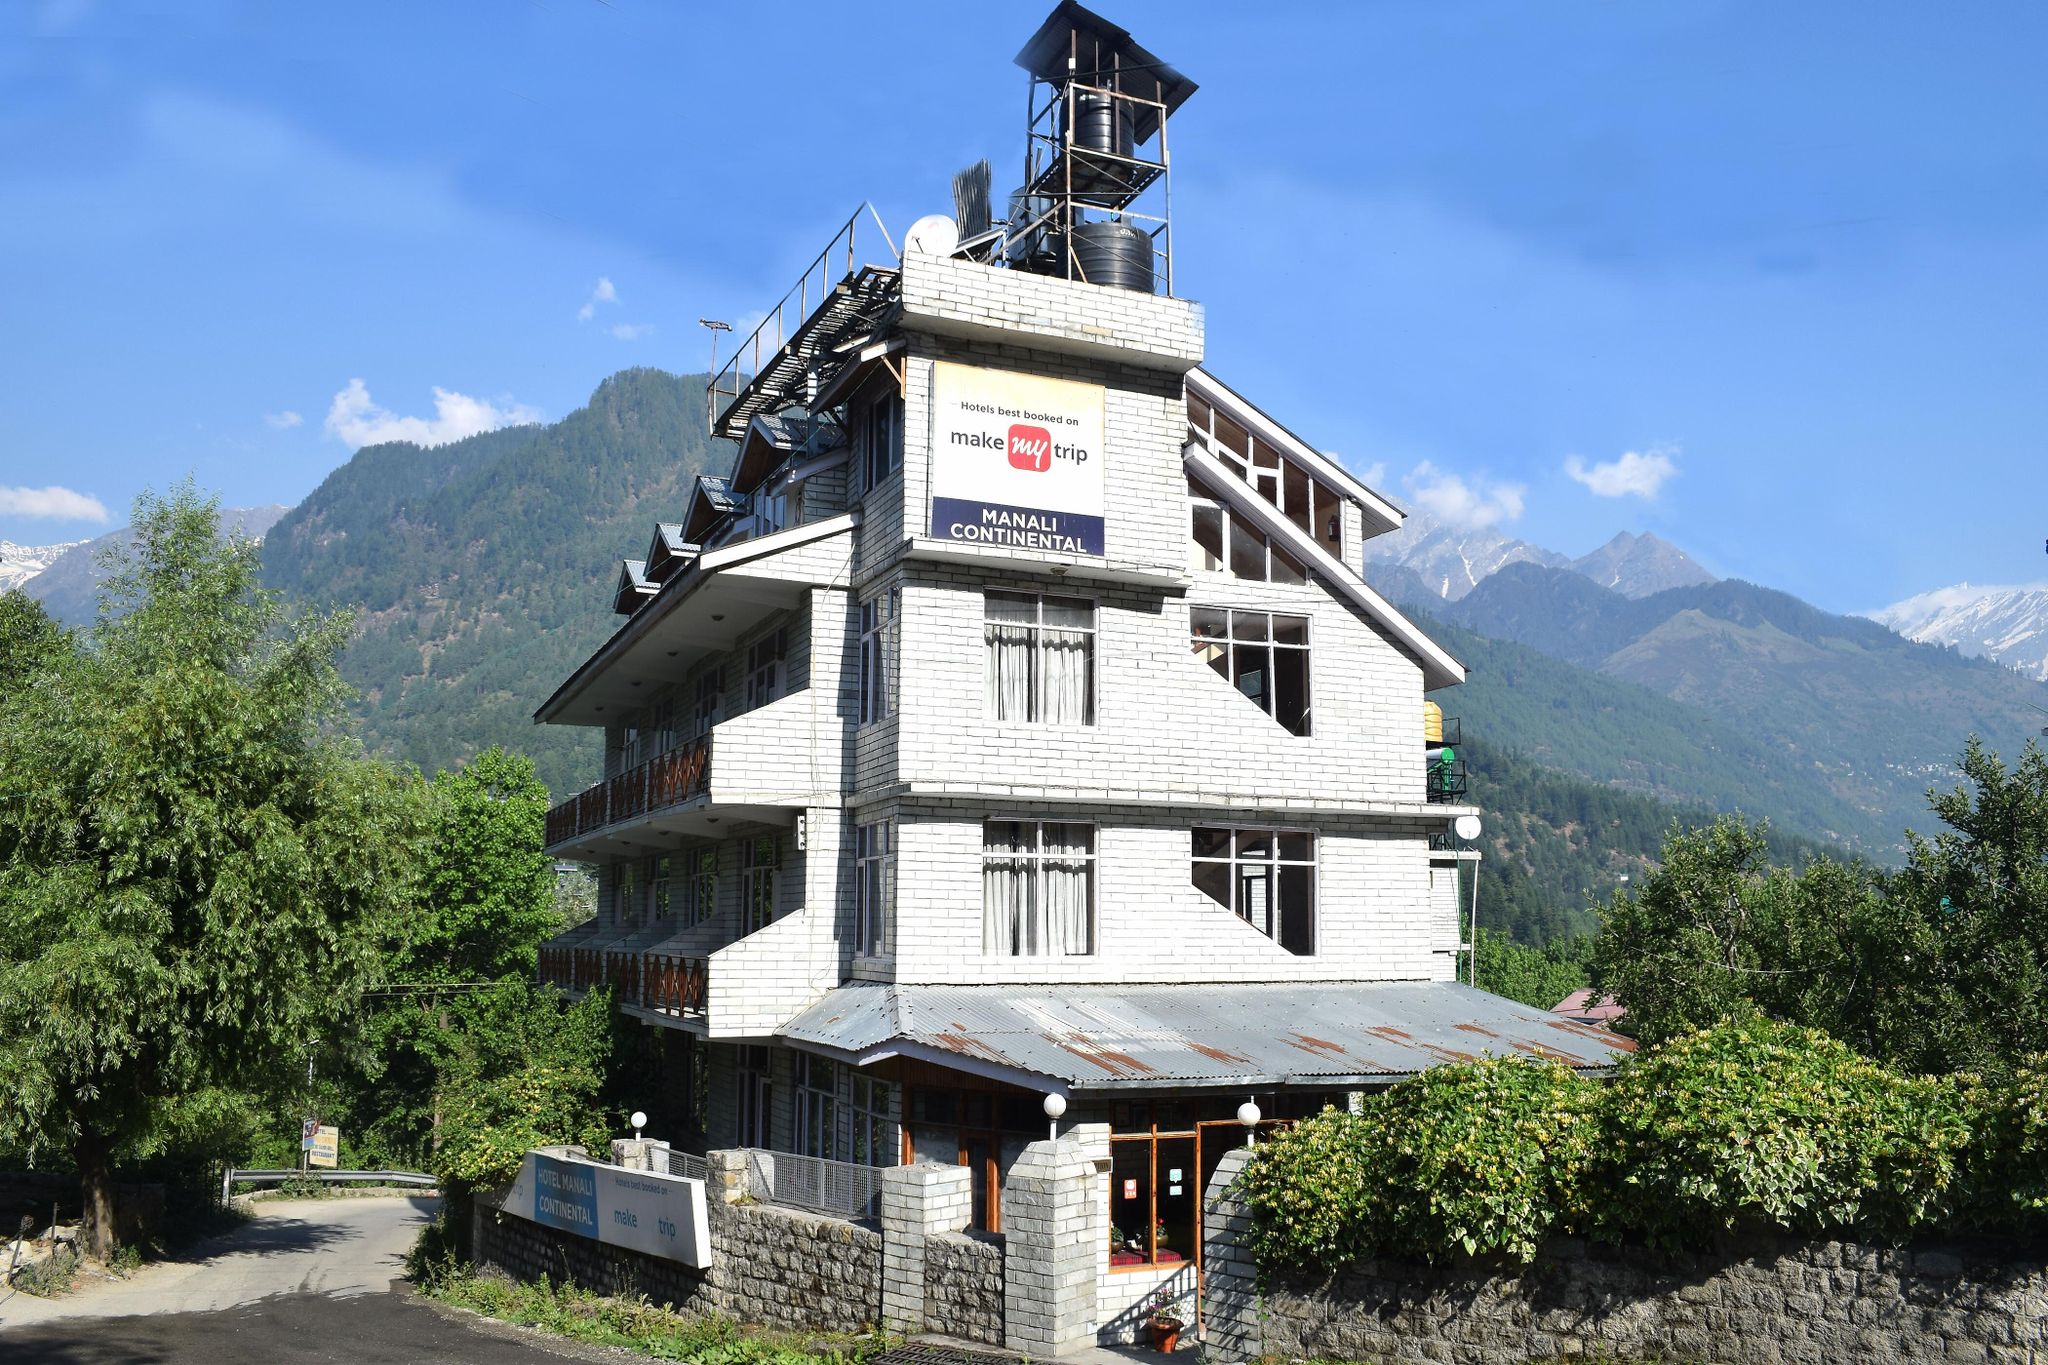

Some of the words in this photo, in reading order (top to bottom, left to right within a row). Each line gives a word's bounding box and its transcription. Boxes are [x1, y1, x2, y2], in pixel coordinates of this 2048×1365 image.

[961, 401, 995, 415] Hotels
[998, 406, 1021, 418] best
[1024, 410, 1063, 424] booked
[1066, 417, 1079, 426] on
[951, 430, 1005, 450] make
[1011, 436, 1049, 469] my
[1054, 443, 1088, 465] trip
[982, 509, 1057, 531] MANALI
[950, 523, 1087, 553] CONTINENTAL
[538, 1168, 561, 1188] HOTEL
[562, 1174, 593, 1196] MANALI
[539, 1195, 593, 1225] CONTINENTAL
[614, 1208, 638, 1228] make
[658, 1216, 677, 1241] trip
